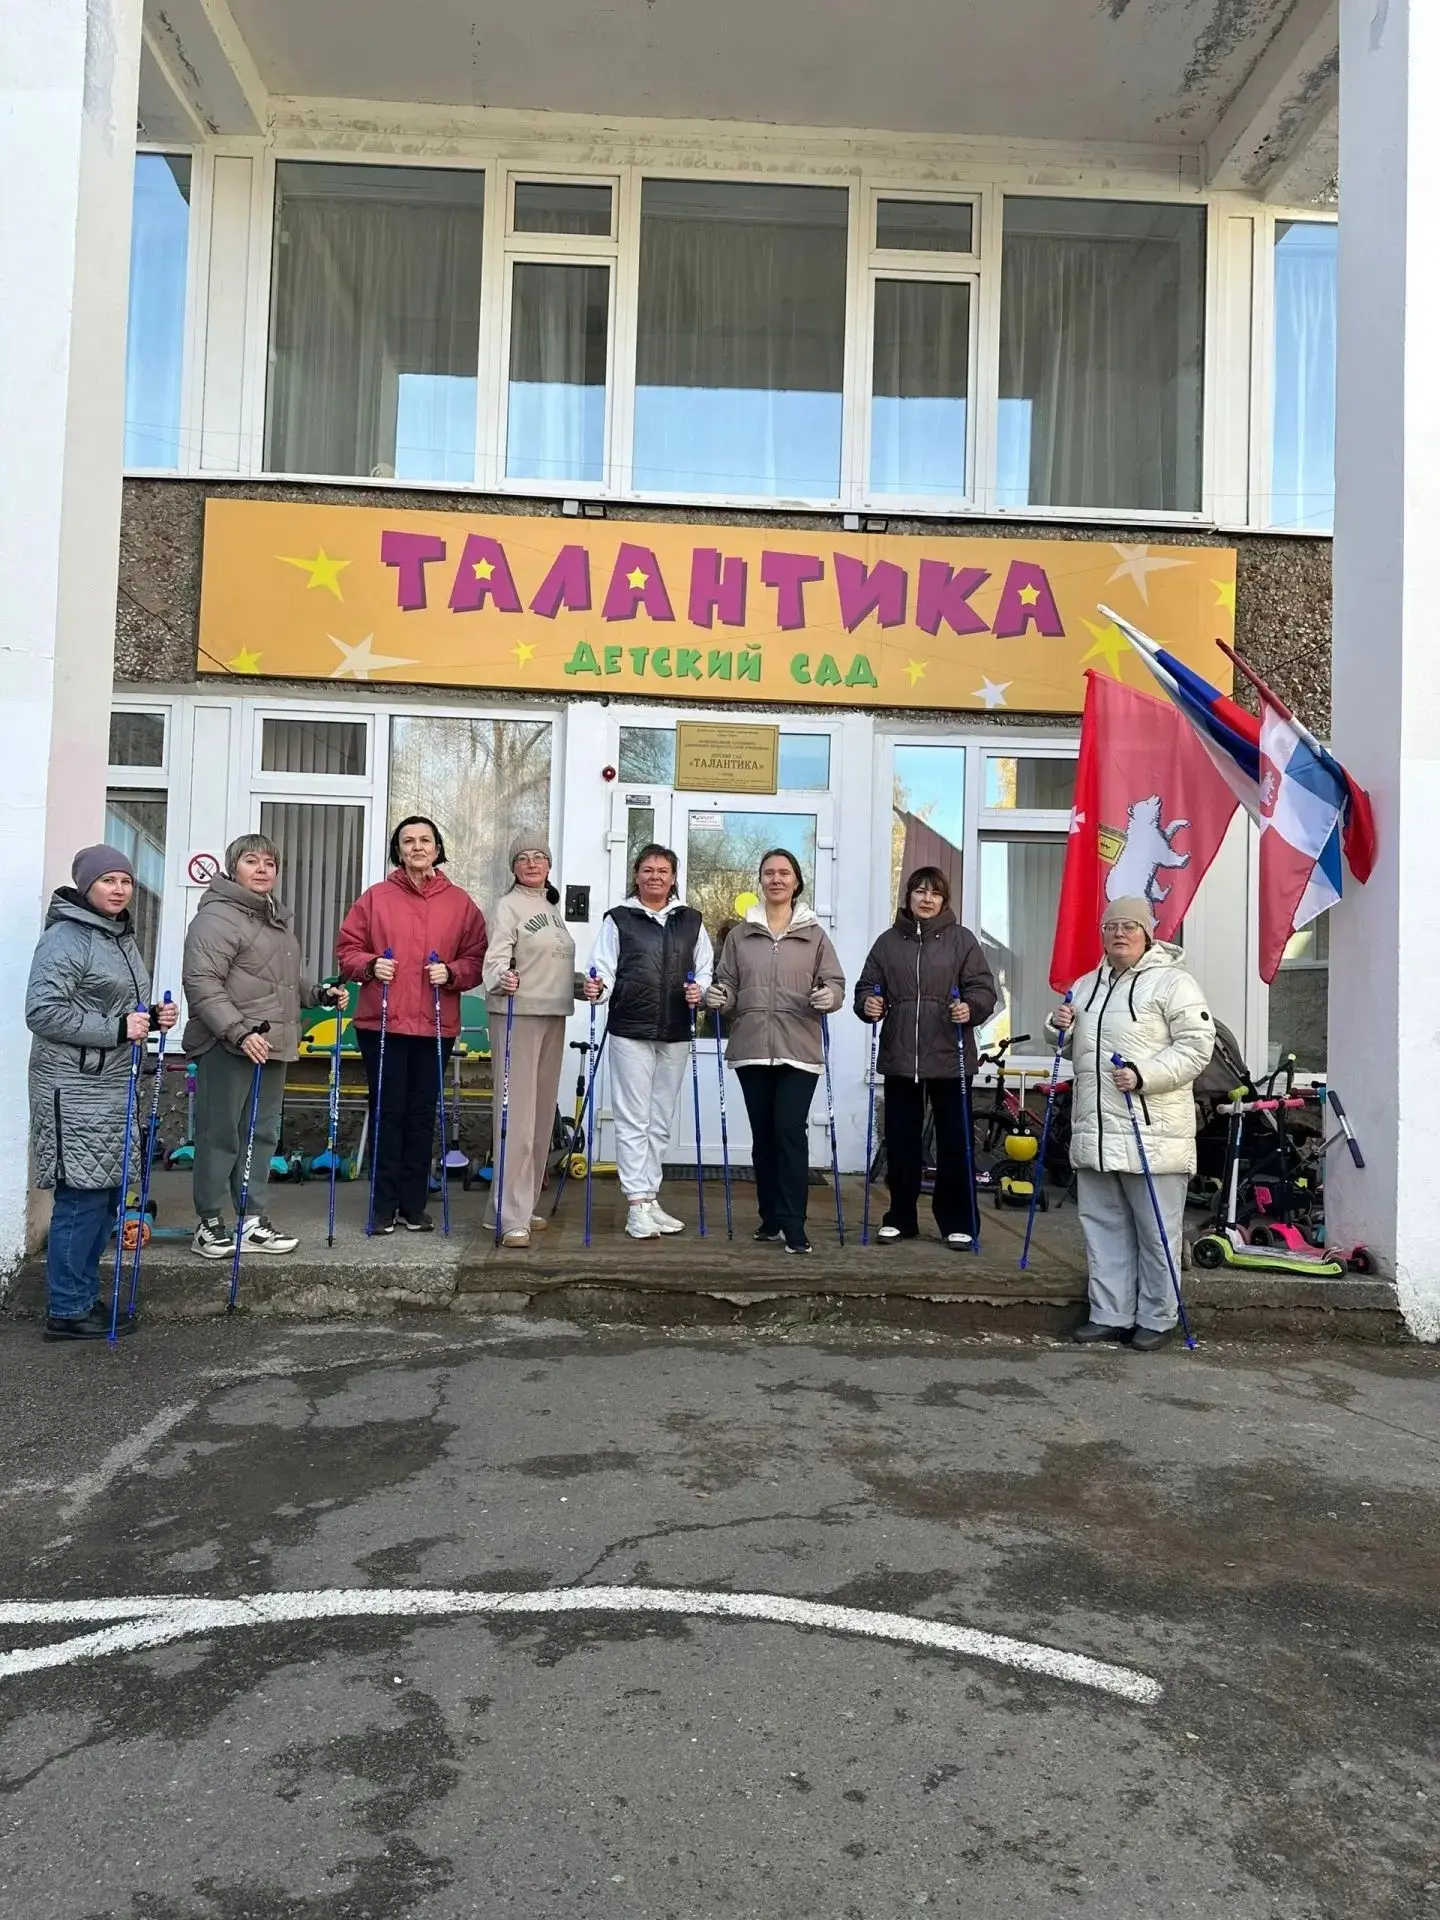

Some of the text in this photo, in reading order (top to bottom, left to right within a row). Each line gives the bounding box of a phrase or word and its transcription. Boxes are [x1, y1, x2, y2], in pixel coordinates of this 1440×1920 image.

[381, 530, 1065, 639] ТАЛАНТИКА
[564, 641, 878, 688] ДЕТСКИЙ САД
[689, 758, 764, 770] «ТАЛАНТИКА»
